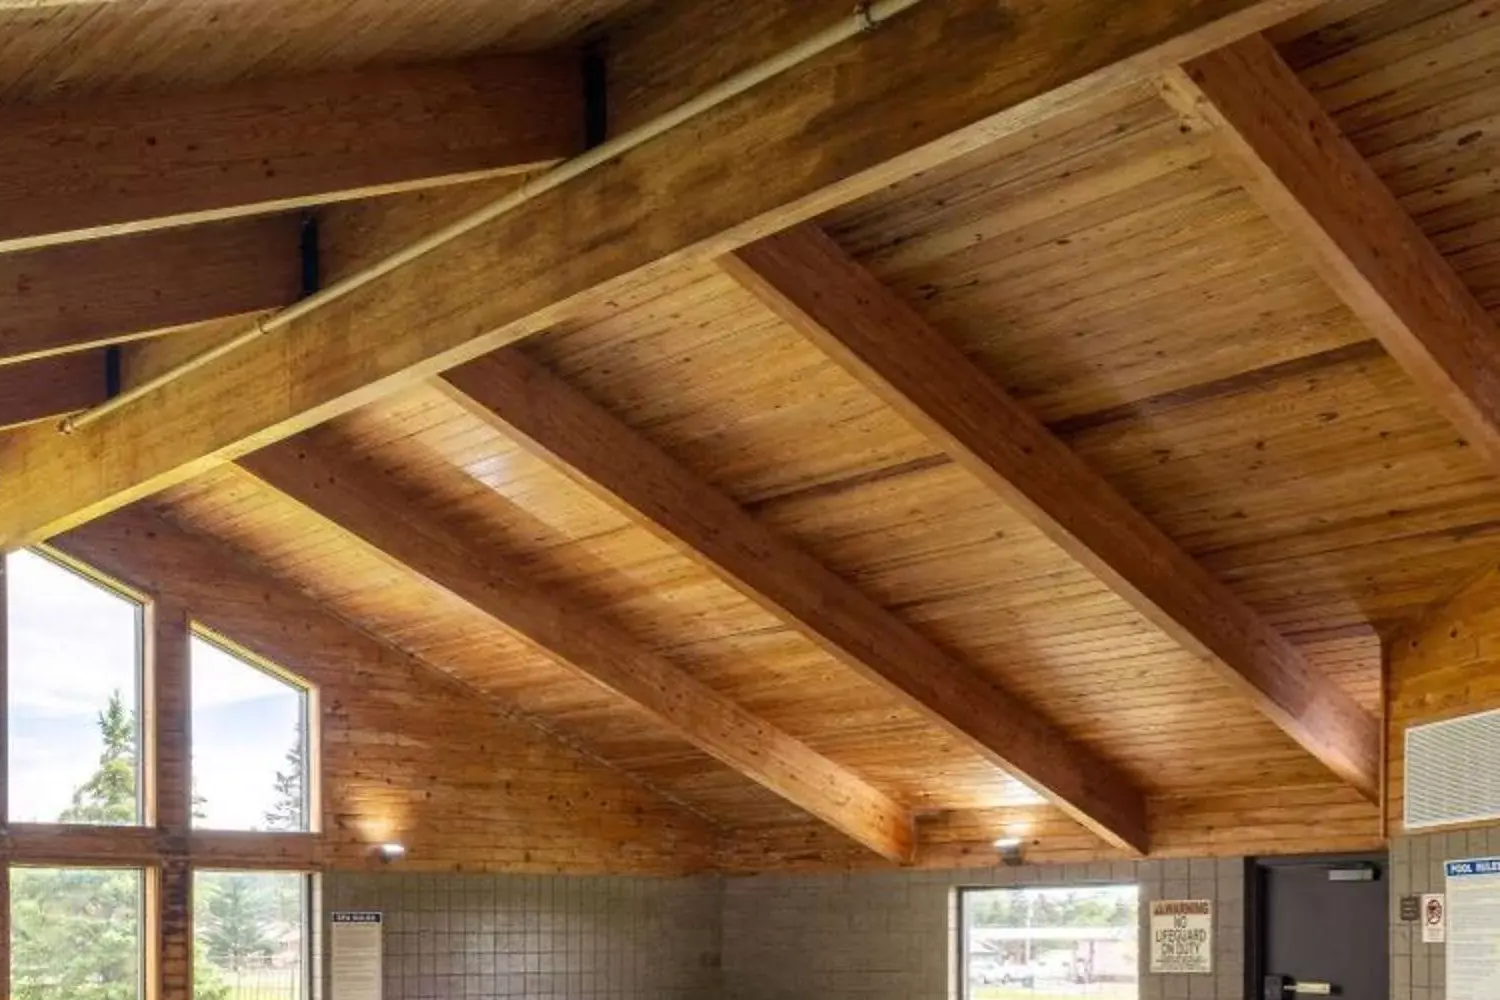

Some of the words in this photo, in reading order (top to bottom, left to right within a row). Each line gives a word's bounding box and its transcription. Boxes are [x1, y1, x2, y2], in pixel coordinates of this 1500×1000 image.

[1451, 863, 1473, 875] POOL
[1174, 915, 1187, 929] NO
[1156, 928, 1207, 943] LIFEGUARD
